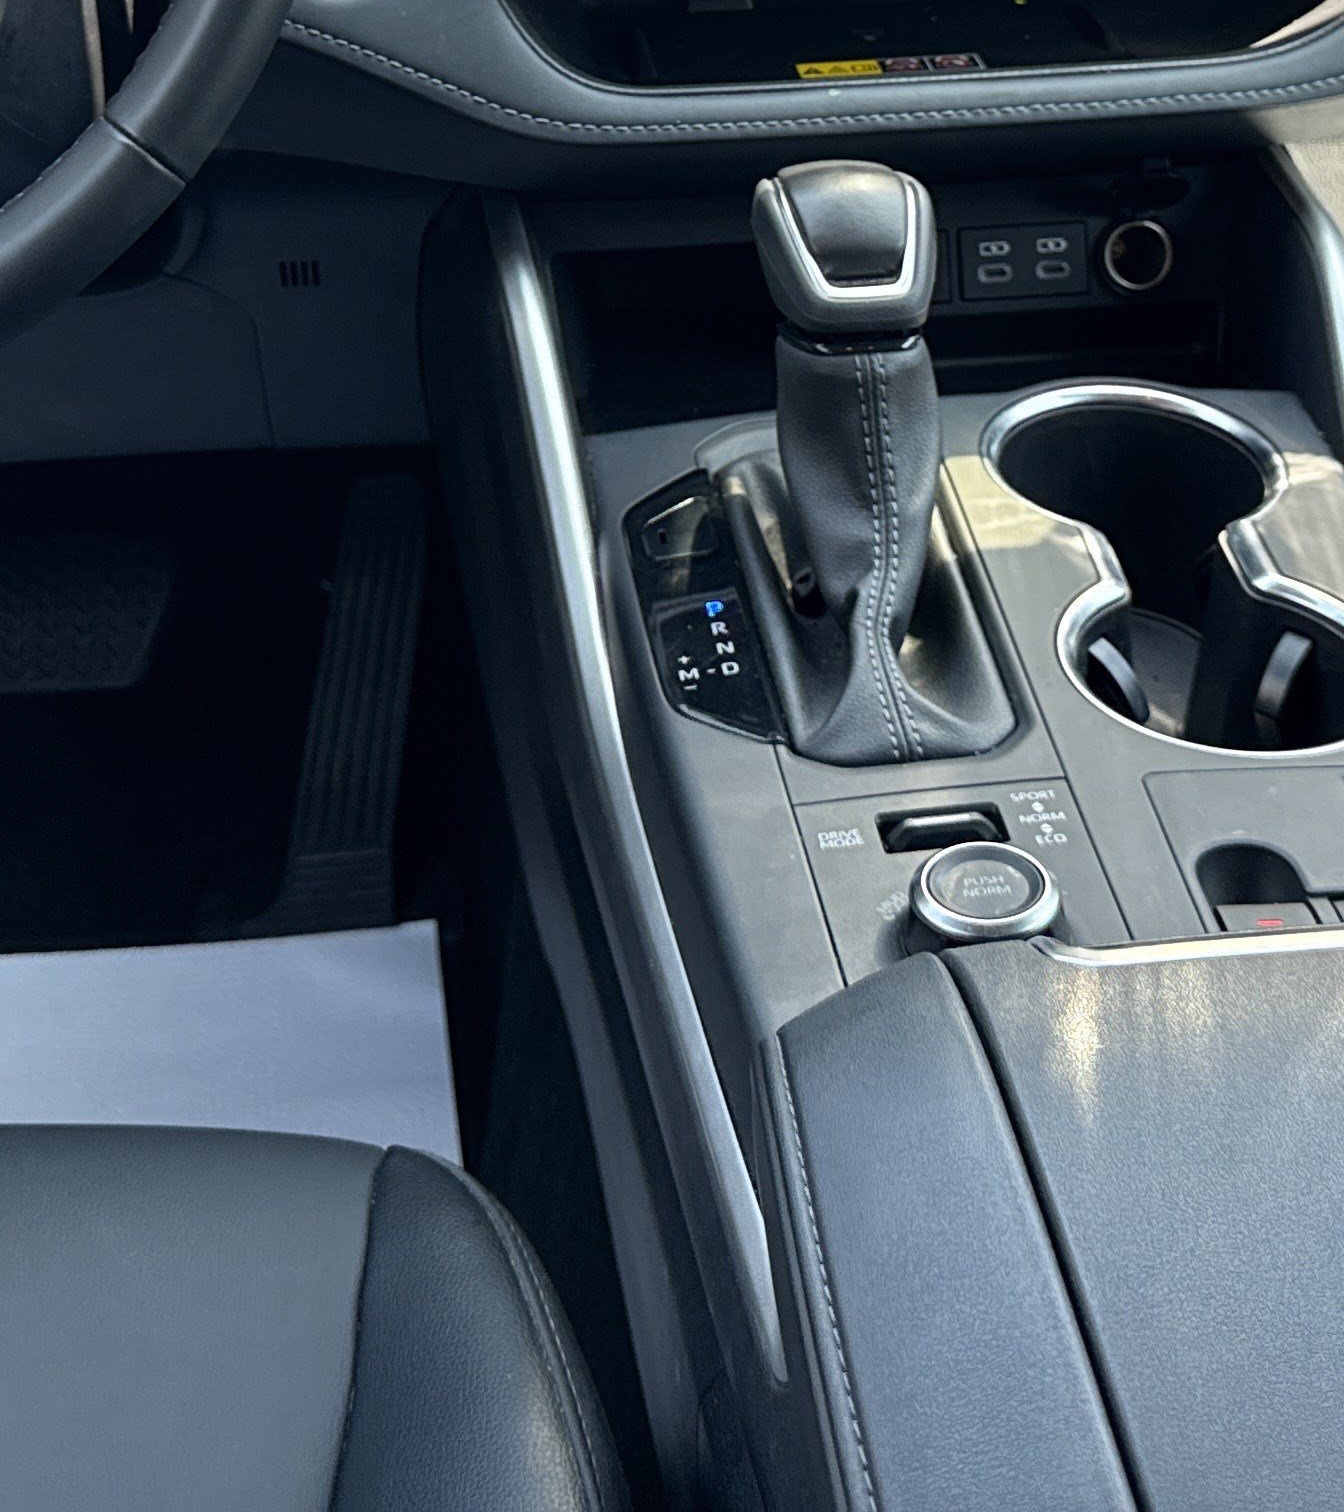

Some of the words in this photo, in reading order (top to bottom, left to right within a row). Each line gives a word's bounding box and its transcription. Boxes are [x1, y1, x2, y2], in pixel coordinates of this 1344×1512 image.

[704, 600, 724, 618] P
[710, 621, 728, 636] R
[716, 641, 735, 655] N
[678, 667, 700, 681] M
[721, 661, 740, 675] D
[1010, 789, 1057, 803] SPORT
[1019, 811, 1066, 825] NORM
[818, 828, 860, 841] DRIVE
[1035, 832, 1068, 847] ECO
[819, 835, 864, 850] MODE
[963, 875, 1005, 886] PUSH
[962, 885, 1012, 897] NORM
